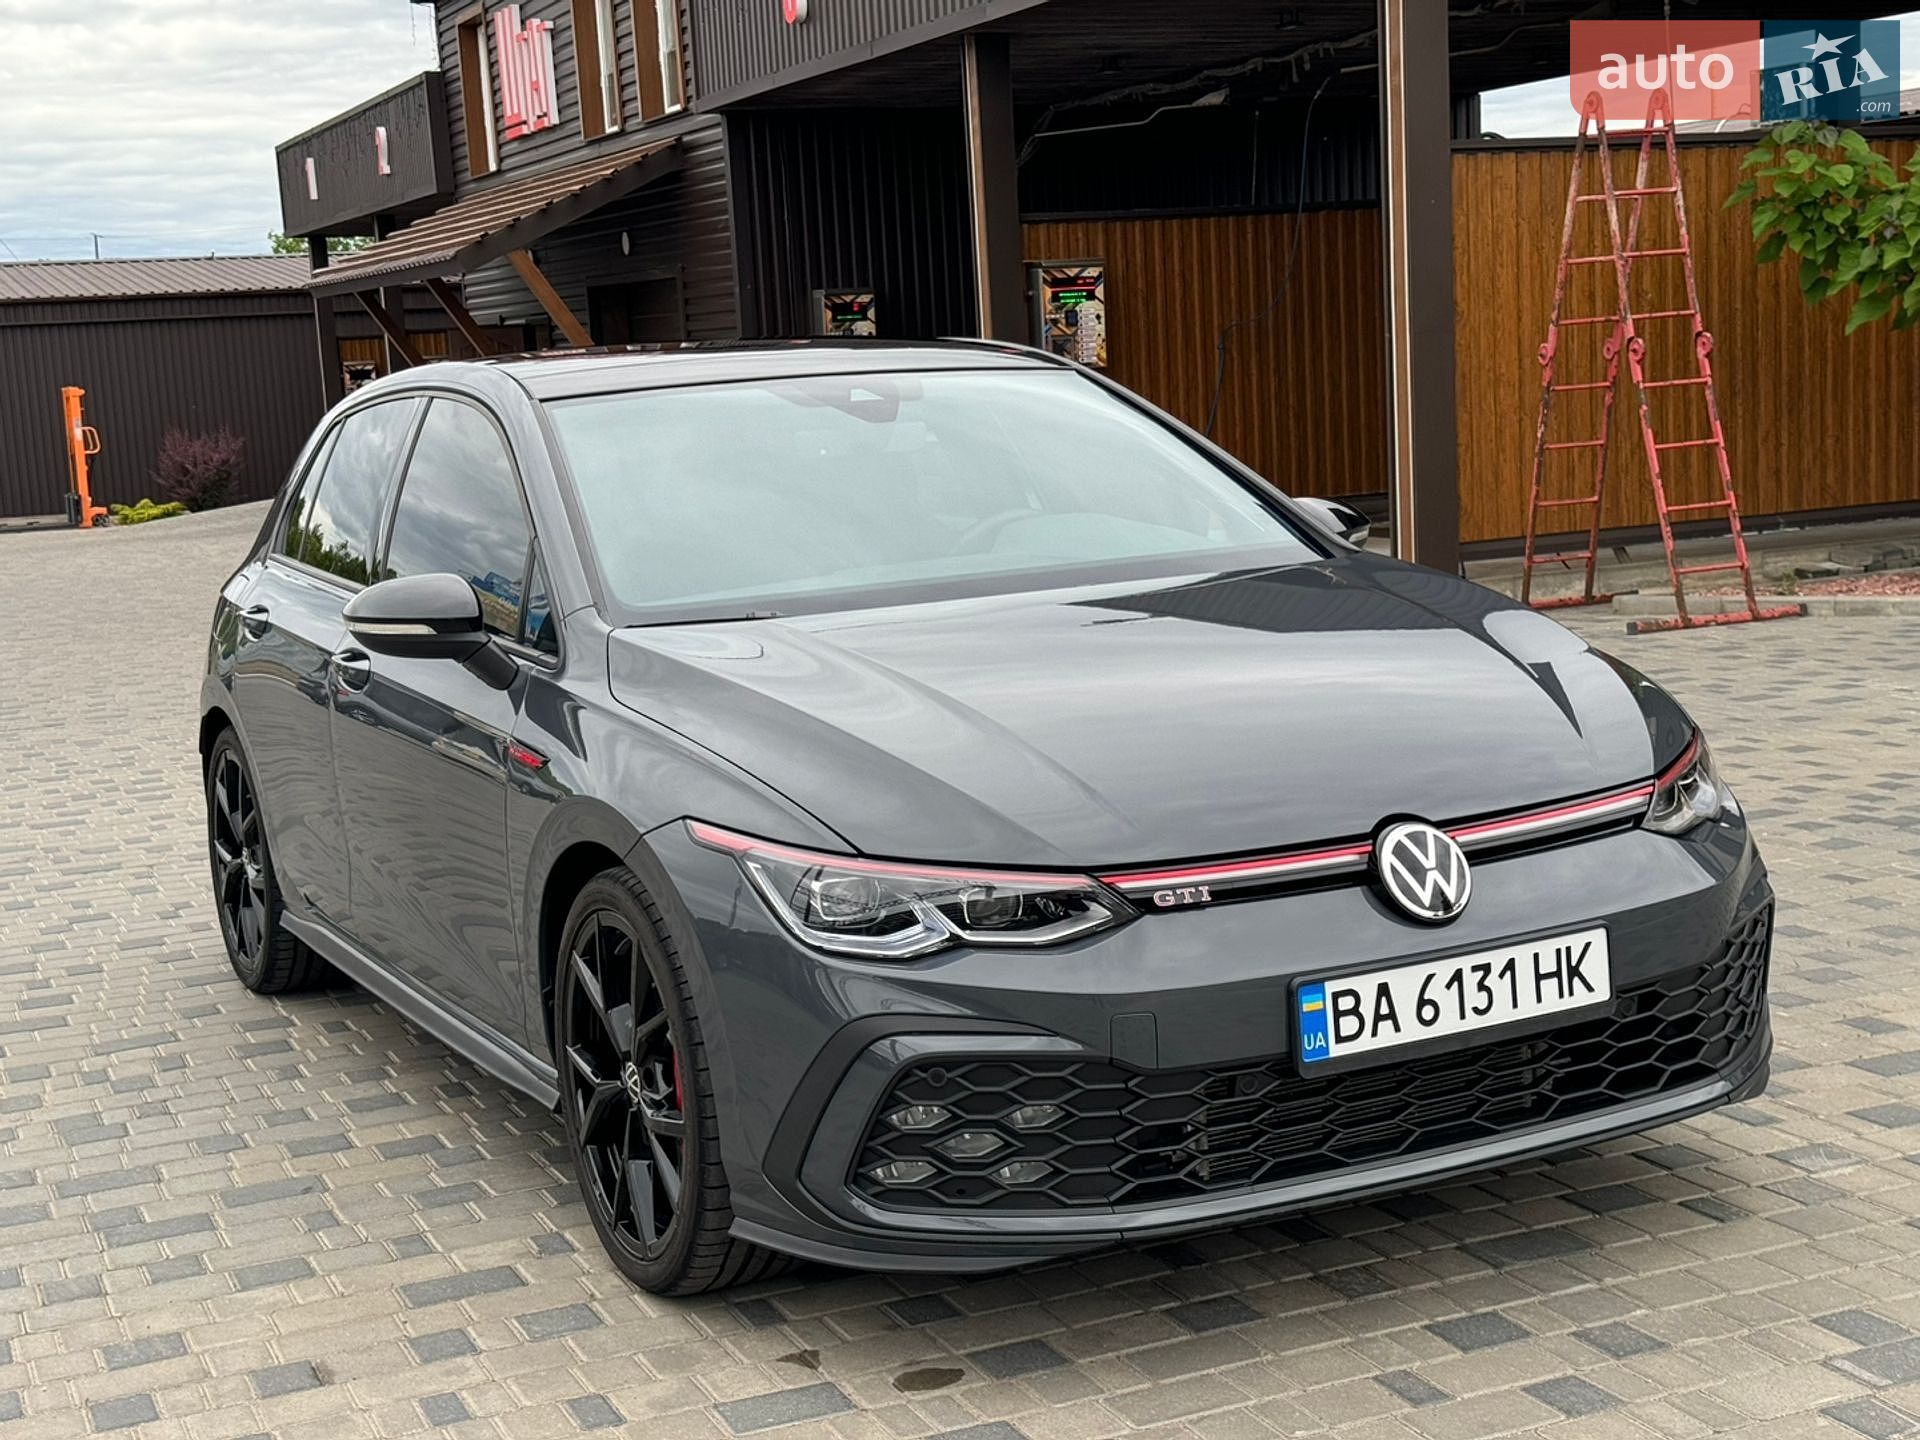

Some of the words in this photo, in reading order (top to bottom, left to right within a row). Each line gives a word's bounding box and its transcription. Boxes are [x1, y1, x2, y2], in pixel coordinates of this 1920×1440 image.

[1153, 885, 1212, 907] GTI
[1331, 982, 1401, 1045] BA
[1416, 957, 1518, 1027] 6131
[1533, 941, 1595, 1004] HK
[1304, 1032, 1327, 1051] UA
